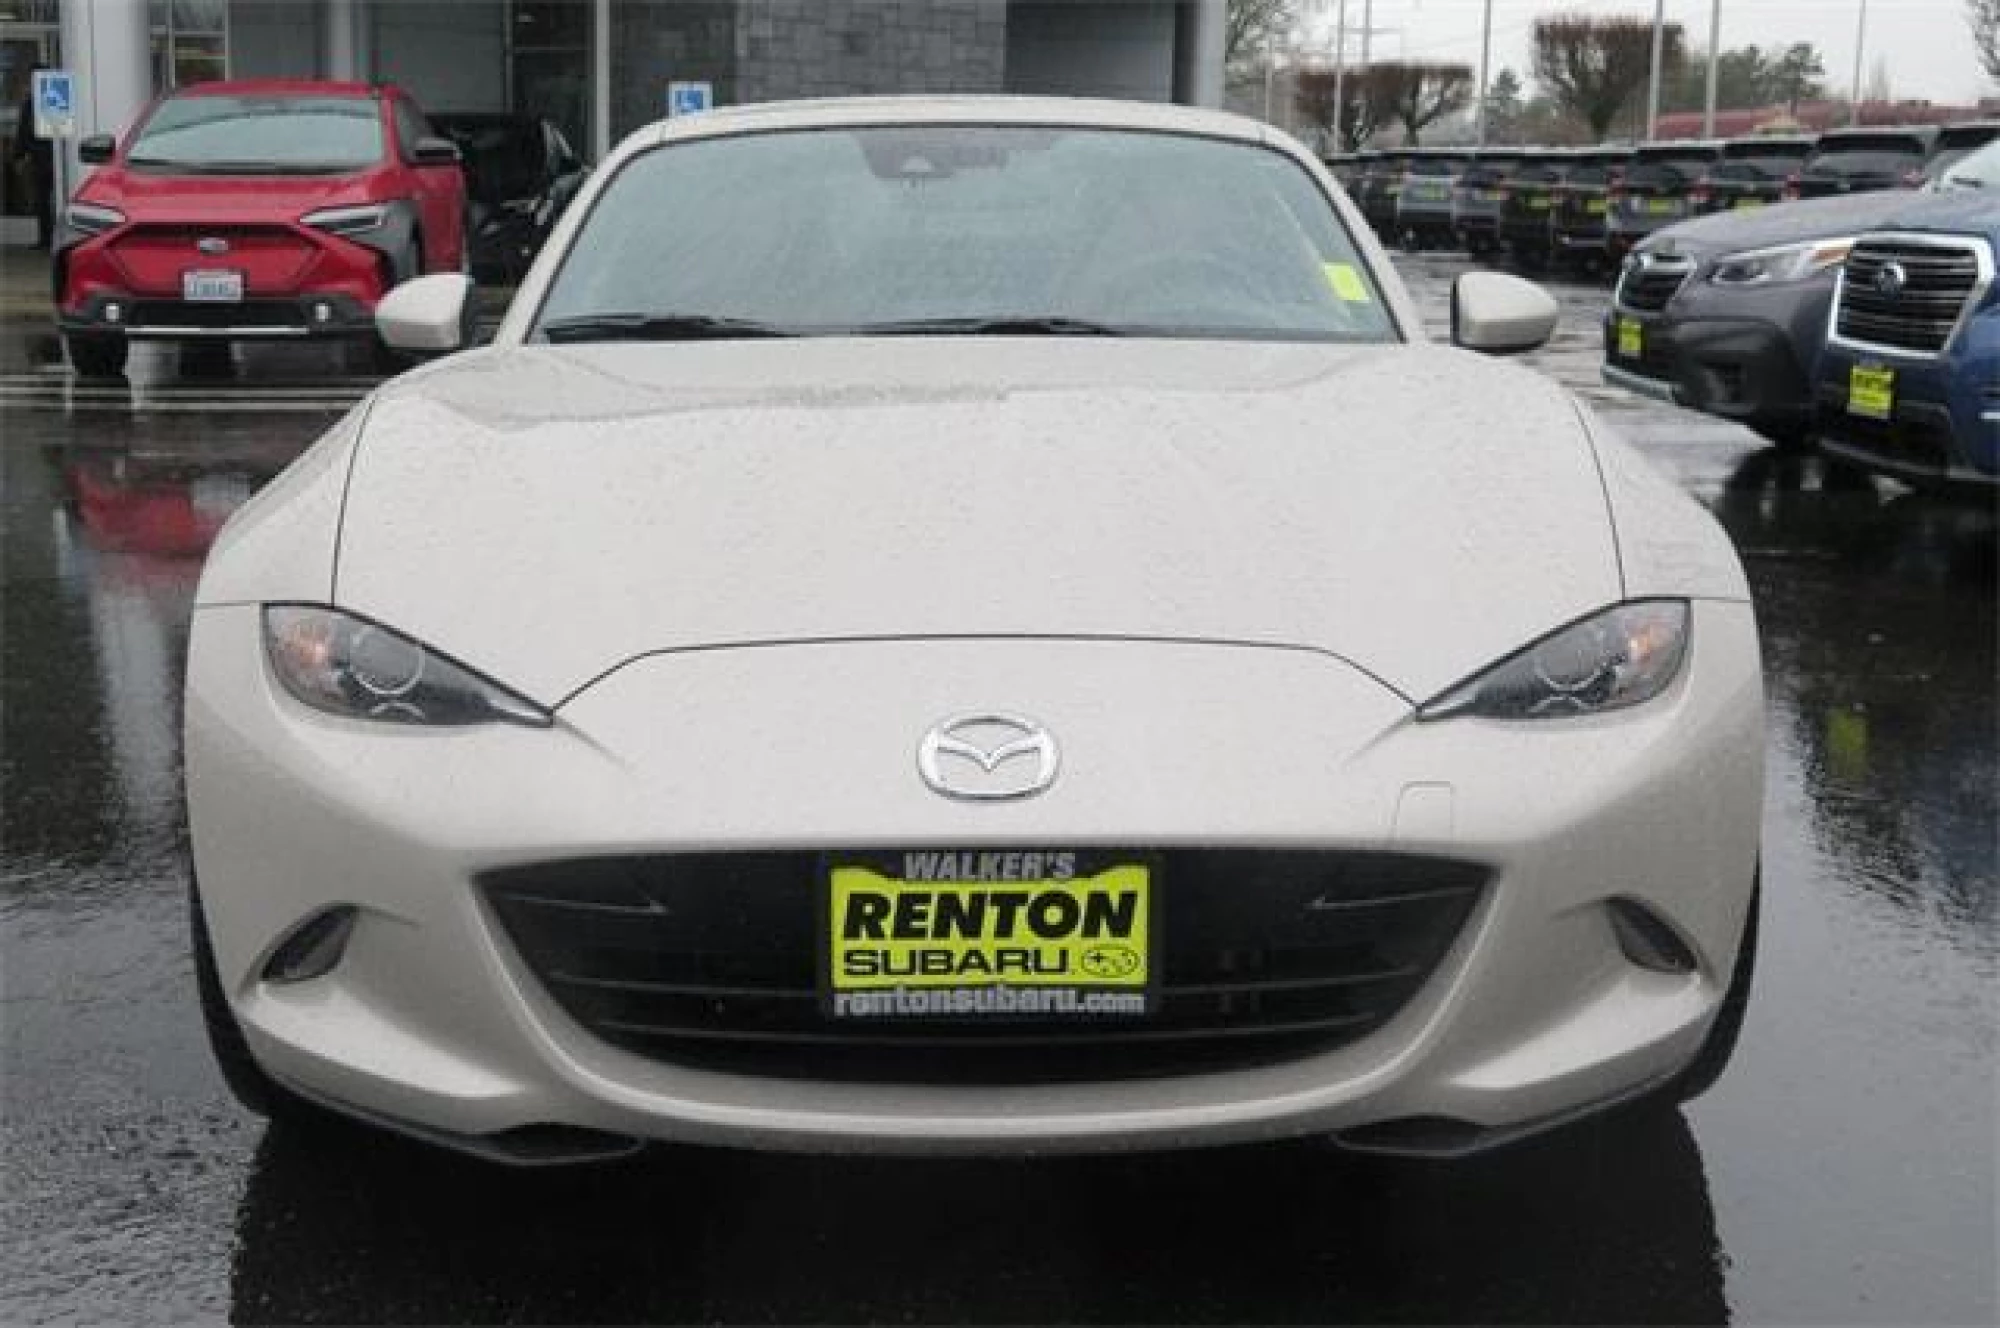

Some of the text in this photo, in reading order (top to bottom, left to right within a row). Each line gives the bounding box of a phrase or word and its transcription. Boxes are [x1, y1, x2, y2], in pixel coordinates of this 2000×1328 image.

[902, 852, 1076, 879] WALKER'S
[843, 890, 1139, 939] RENTON
[844, 949, 1070, 976] SUBARU
[834, 985, 1146, 1016] rentonsubaru.com
